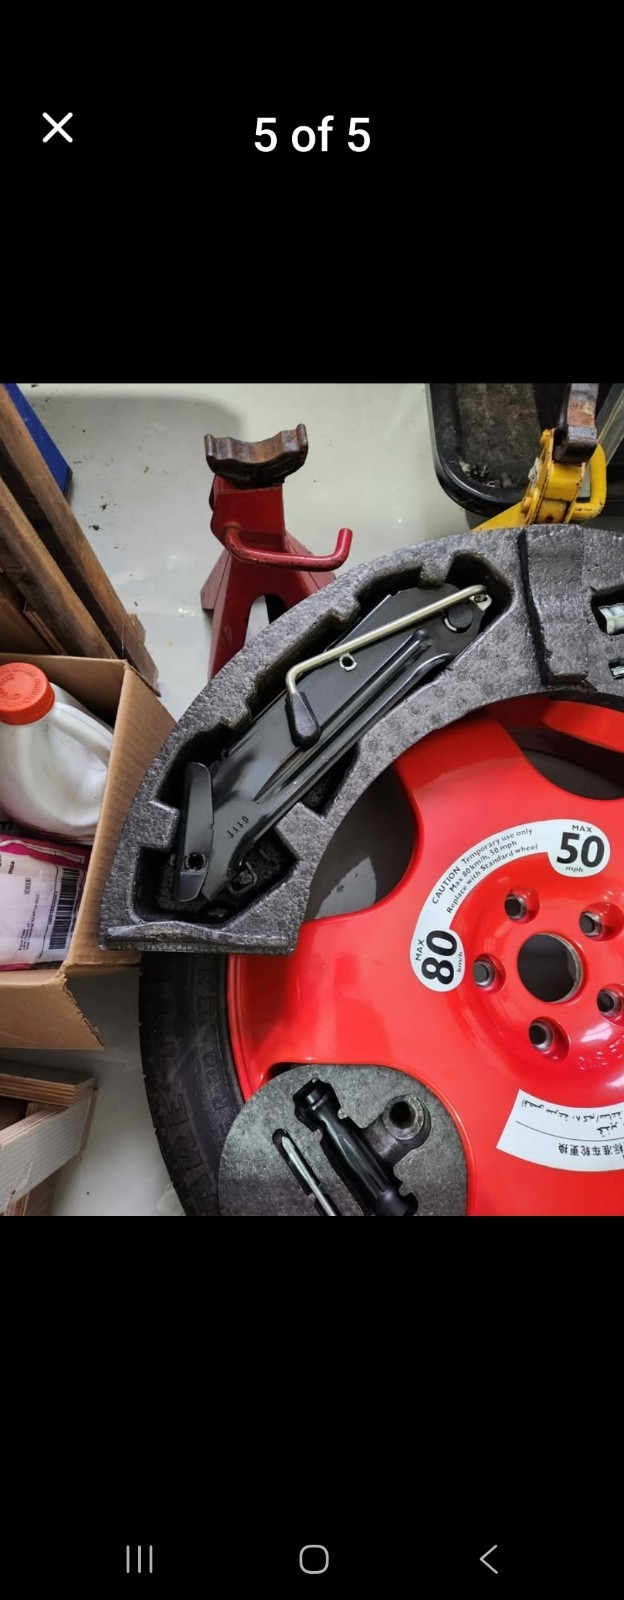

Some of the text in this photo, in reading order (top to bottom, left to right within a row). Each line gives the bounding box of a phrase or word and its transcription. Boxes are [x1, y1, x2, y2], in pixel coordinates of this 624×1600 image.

[556, 832, 605, 868] 50
[572, 825, 592, 833] MAX
[432, 828, 533, 904] CAUTION Temporary use only
[446, 843, 538, 914] Replace with Standard wheel
[449, 877, 463, 892] Max
[462, 867, 471, 877] 80
[489, 847, 499, 856] 50
[500, 840, 518, 852] mph
[415, 939, 424, 961] MAX
[421, 930, 458, 985] 80
